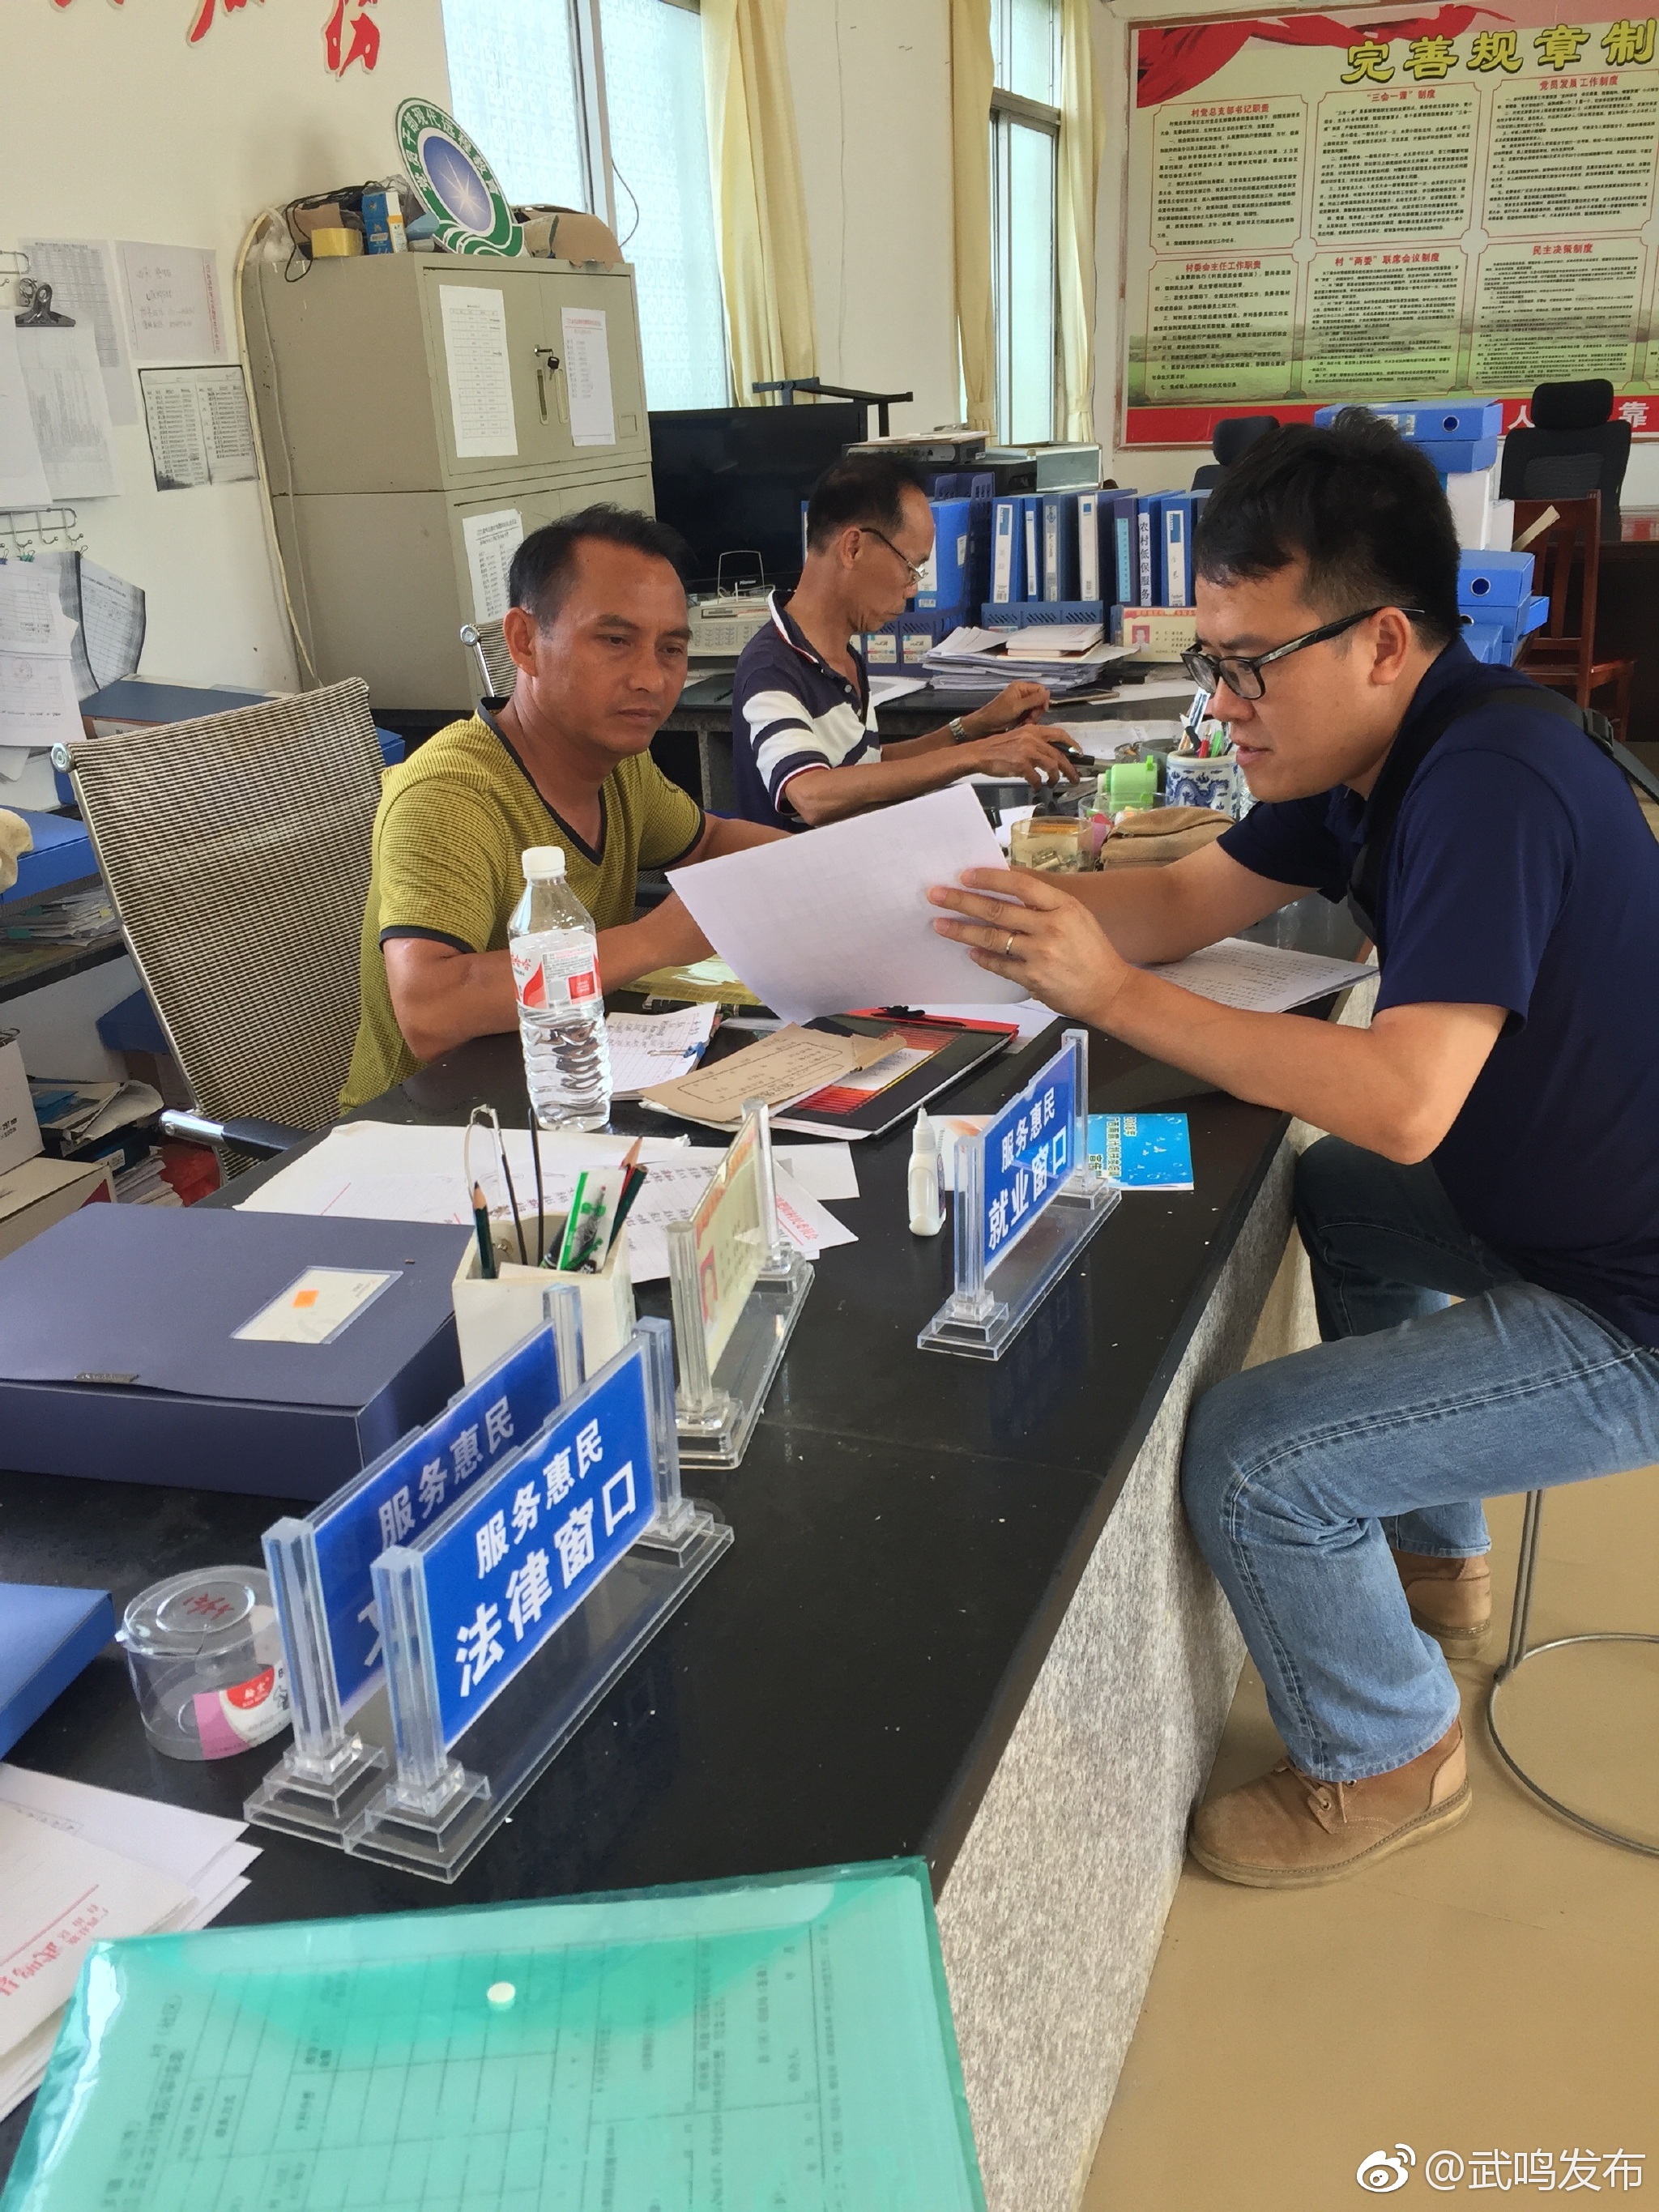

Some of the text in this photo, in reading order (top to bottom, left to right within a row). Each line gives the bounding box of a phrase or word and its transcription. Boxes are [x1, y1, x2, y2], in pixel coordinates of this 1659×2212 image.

[1341, 17, 1658, 84] 完善规章制
[1539, 75, 1619, 92] 党员发展工作制度
[402, 106, 501, 197] 党员干部现代远程教
[1190, 103, 1270, 118] 村党总支部书记职责
[1185, 260, 1262, 273] 村委会主任工作职责
[1532, 243, 1593, 256] 民主决策制度
[1140, 521, 1150, 601] 农村低保服务
[1001, 1086, 1056, 1174] 服务惠民
[987, 1125, 1068, 1251] 就业窗口
[377, 1395, 515, 1548] 服务惠民
[475, 1418, 604, 1580] 服务惠民
[454, 1460, 638, 1698] 法律窗口
